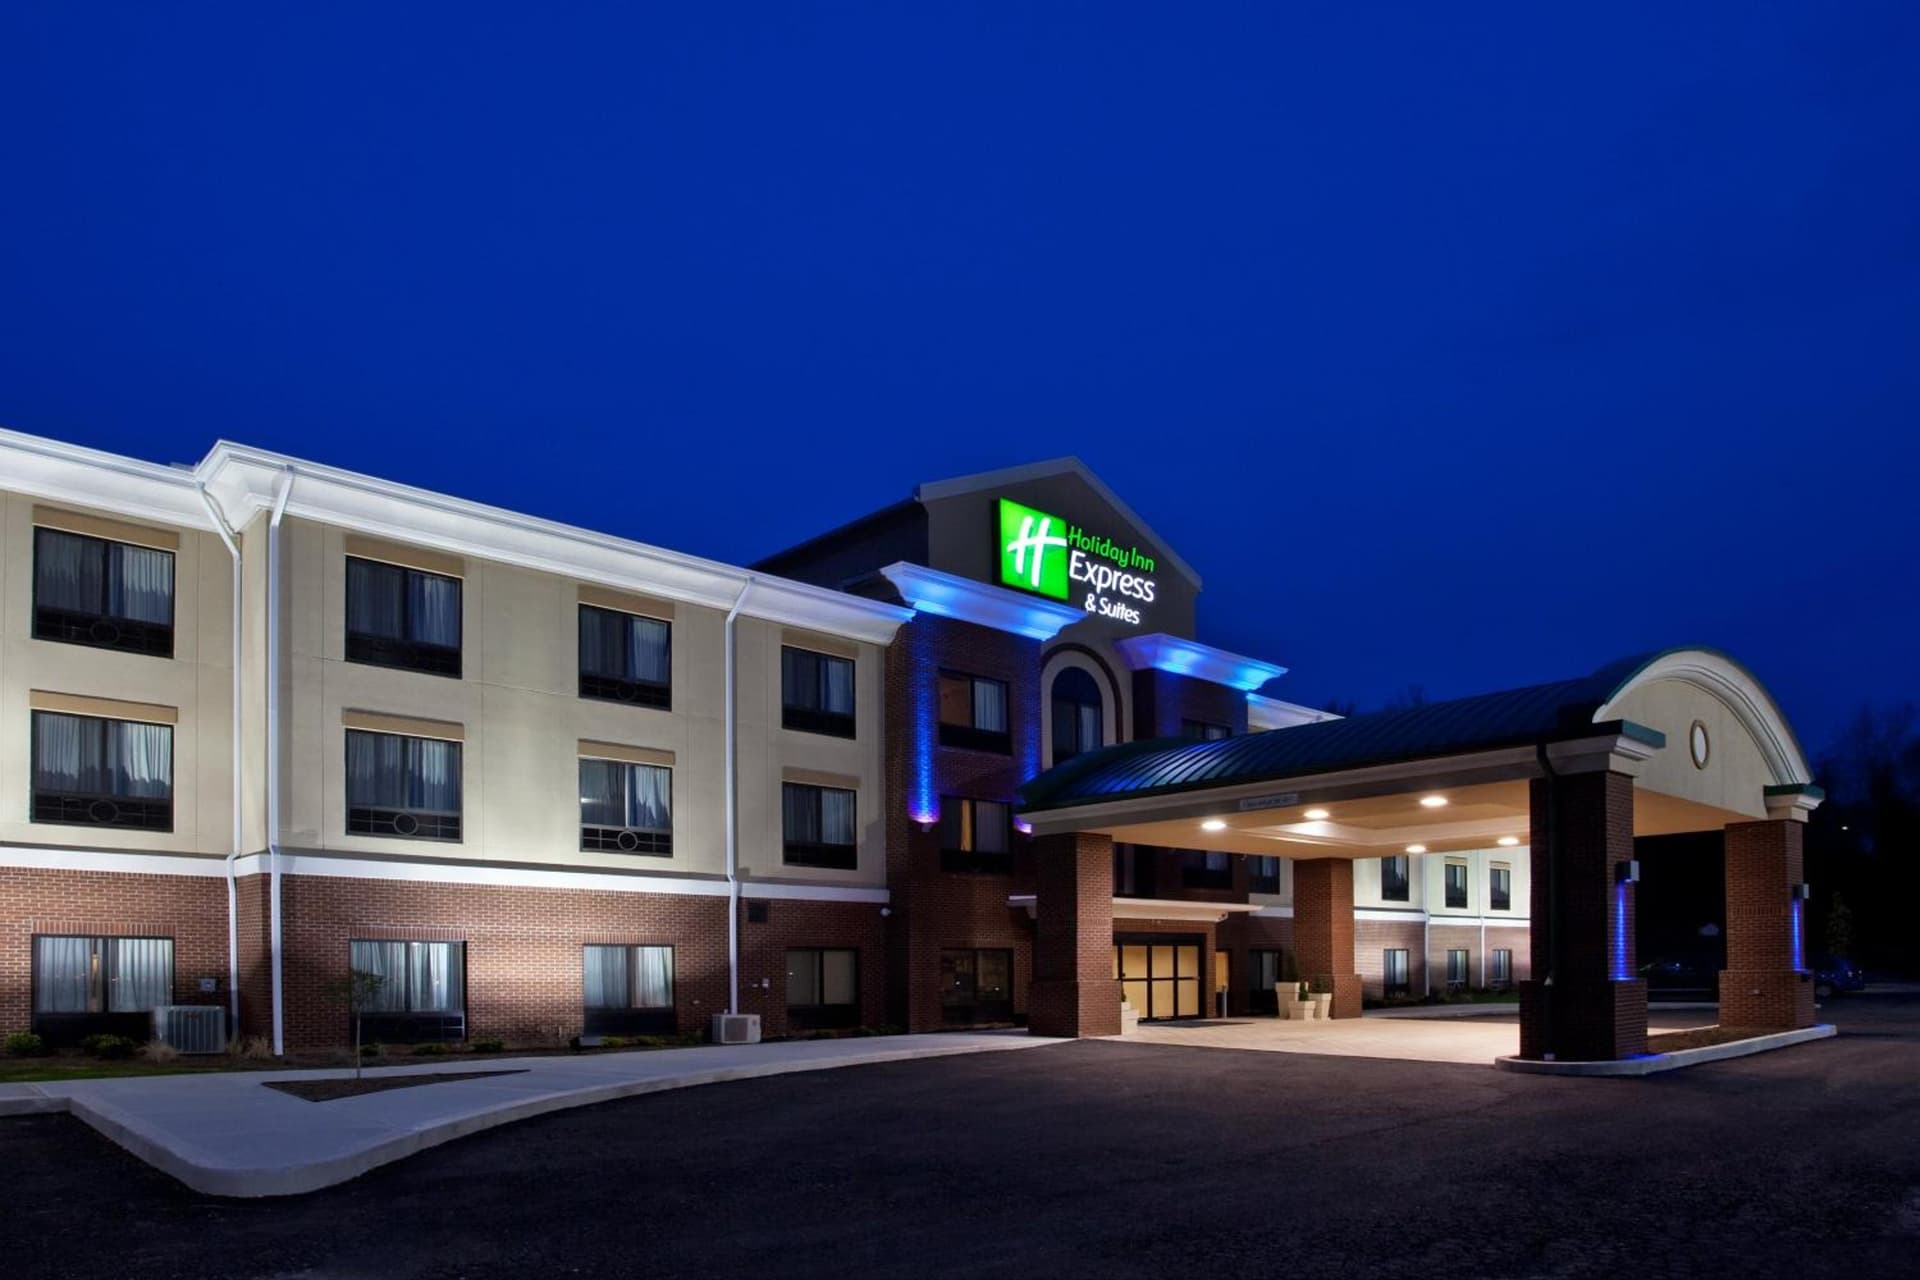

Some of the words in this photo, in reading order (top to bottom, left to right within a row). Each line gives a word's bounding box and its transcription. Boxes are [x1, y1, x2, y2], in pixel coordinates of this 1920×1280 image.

[1068, 526, 1129, 568] Holiday
[1132, 547, 1154, 572] Inn
[1069, 550, 1155, 602] Express
[1085, 593, 1096, 612] &
[1098, 598, 1140, 624] Suites
